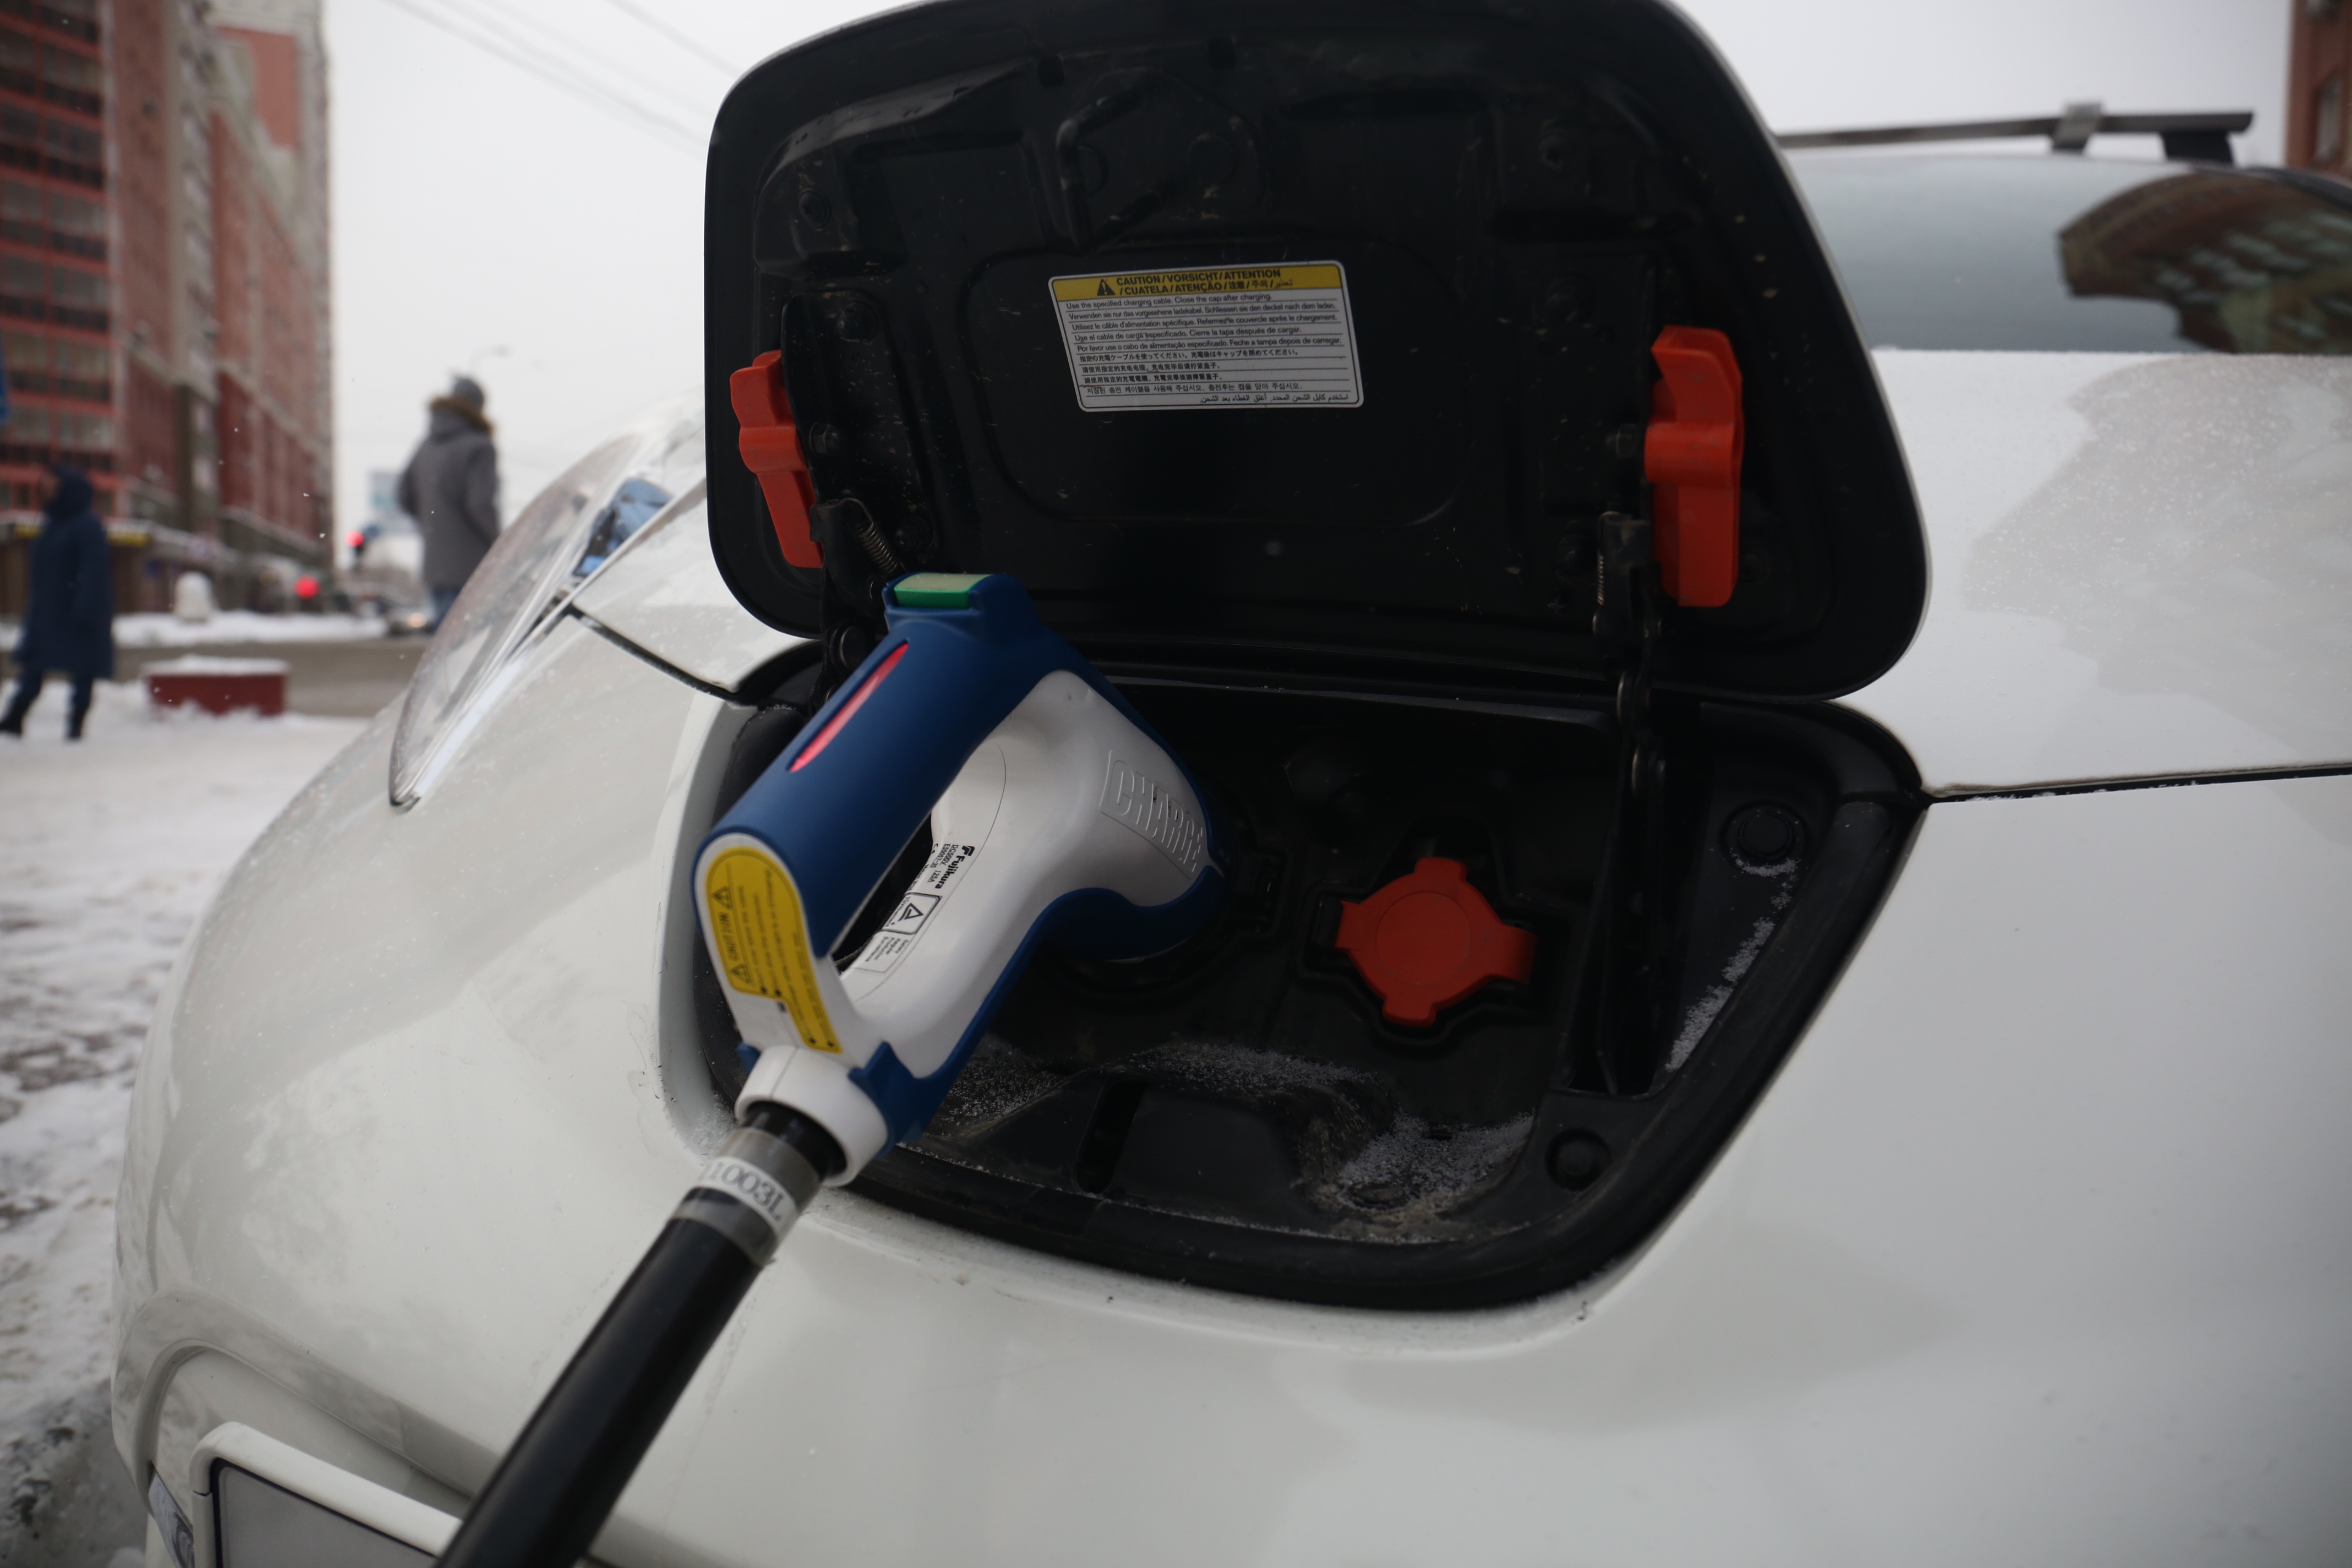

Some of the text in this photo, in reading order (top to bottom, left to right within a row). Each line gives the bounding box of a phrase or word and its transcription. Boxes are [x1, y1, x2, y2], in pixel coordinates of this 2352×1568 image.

[1092, 300, 1122, 309] specified
[1134, 309, 1172, 318] vorgesehene
[1101, 322, 1119, 330] câble
[1119, 320, 1161, 329] d'alimentation
[1161, 318, 1196, 328] spécifique.
[1235, 315, 1267, 325] couvercle
[1268, 315, 1287, 324] après
[1295, 314, 1337, 323] chargement.
[1235, 327, 1265, 336] después
[1148, 341, 1186, 350] alimentação
[1278, 337, 1301, 346] depois
[935, 855, 965, 889] Fujikura
